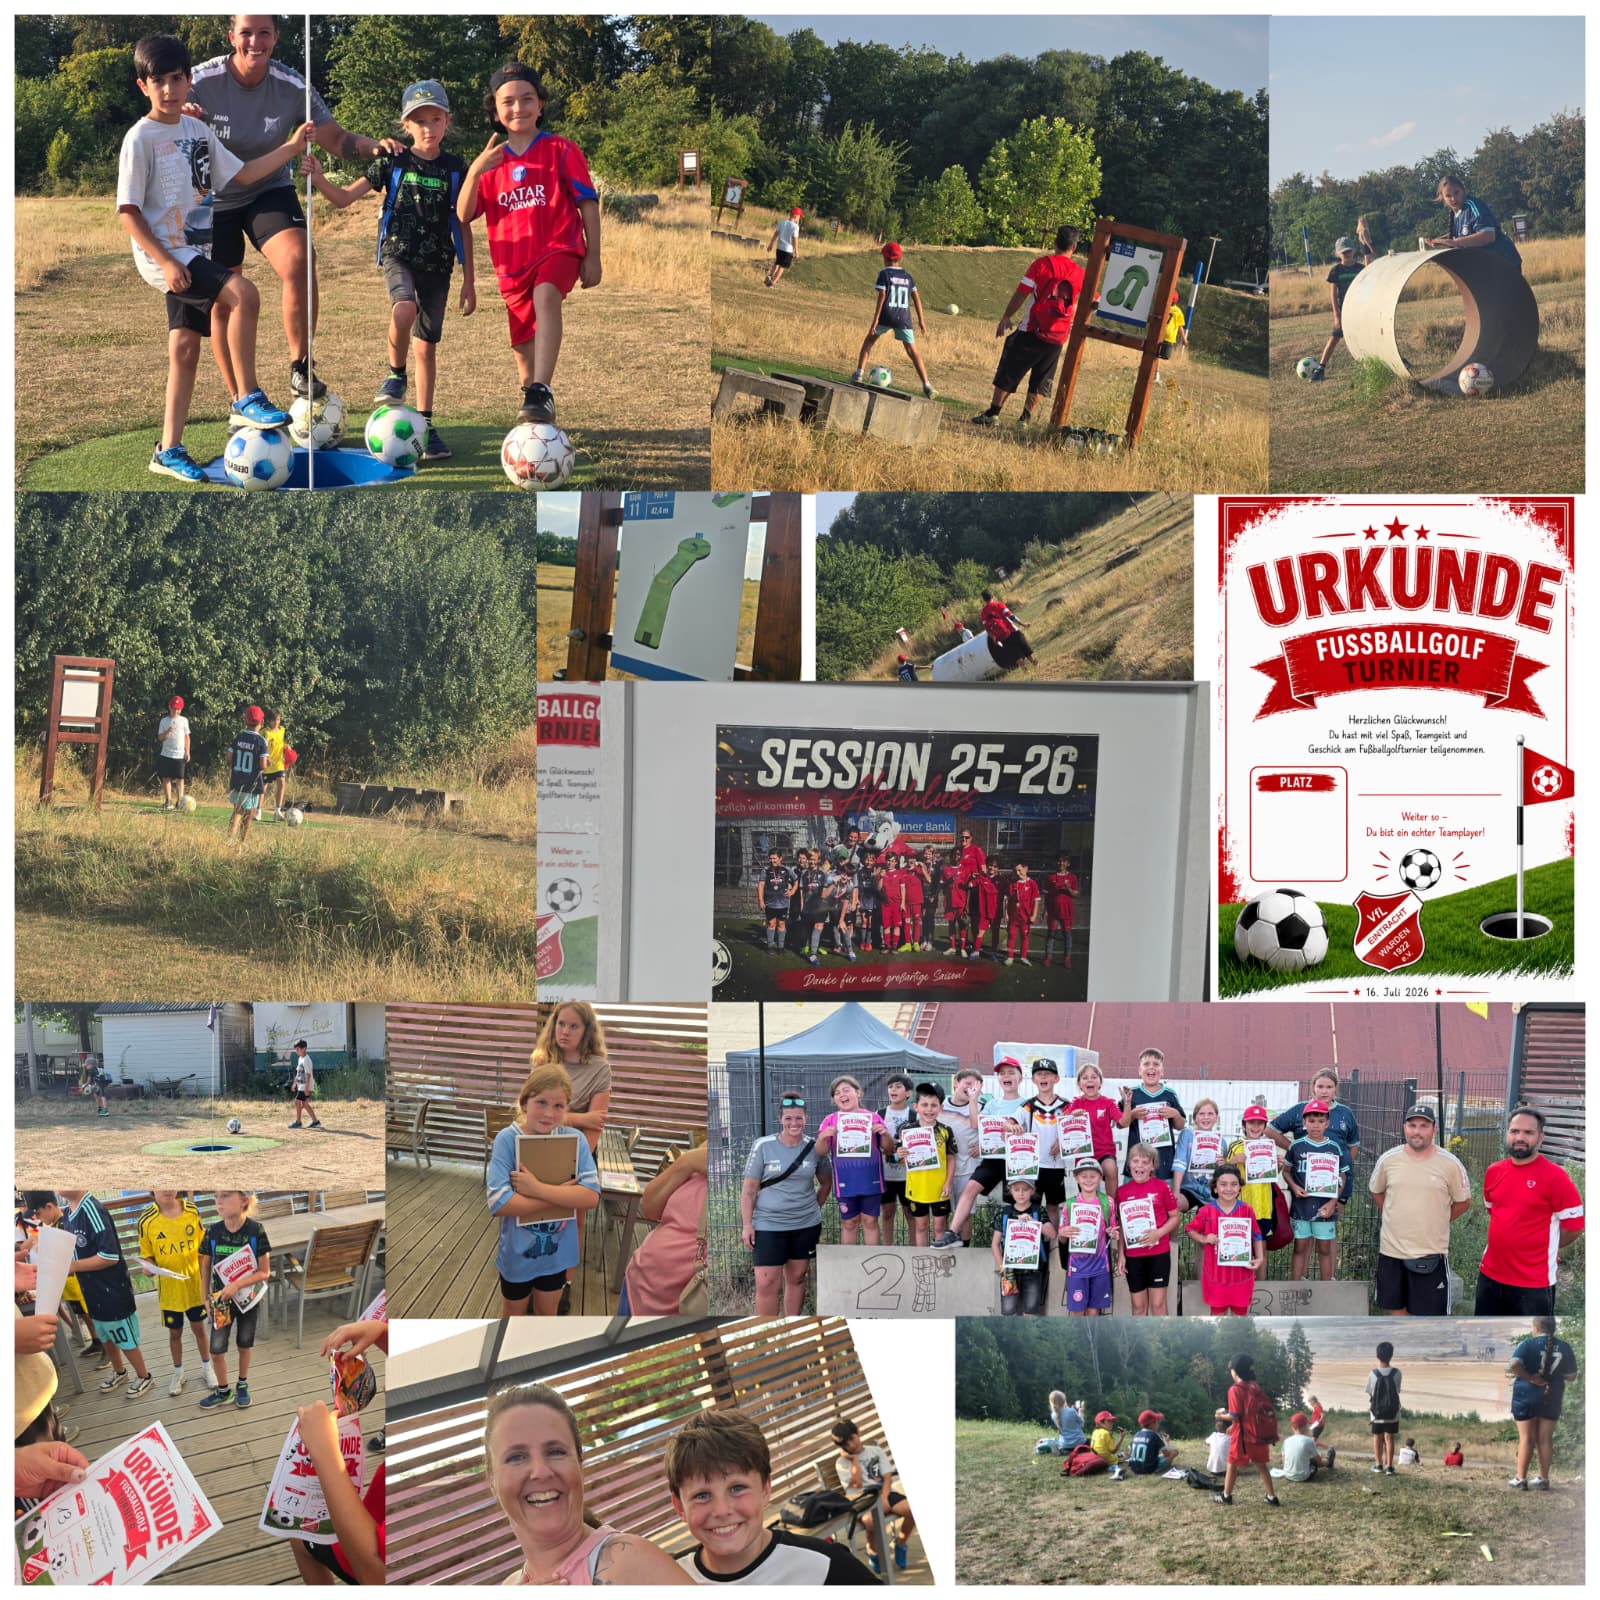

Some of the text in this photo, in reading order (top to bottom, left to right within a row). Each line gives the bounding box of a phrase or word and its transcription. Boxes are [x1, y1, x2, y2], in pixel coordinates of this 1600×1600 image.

[498, 184, 546, 207] QATAR
[508, 198, 546, 212] AIRWAYS
[888, 285, 908, 308] 10
[630, 502, 640, 518] 11
[1246, 544, 1565, 634] URKUNDE
[1316, 630, 1487, 662] FUSSBALLGOLF
[1342, 658, 1462, 686] TURNIER
[1349, 714, 1447, 725] Herzlichen Glückwunsch!
[1329, 730, 1468, 742] Du hast mit viel Spaß, Teamgeist und
[1308, 744, 1342, 754] Geschick
[1359, 744, 1427, 756] Fußballgolfturnier
[1430, 744, 1486, 756] teilgenommen.
[234, 750, 254, 772] 10
[757, 738, 1080, 794] SESSION 25-26
[1280, 775, 1314, 790] PLATZ
[838, 771, 980, 818] Abschluss
[926, 821, 952, 832] Bank
[1402, 812, 1428, 821] Weiter
[1366, 826, 1485, 840] Du bist ein echter Teamplayer!
[1366, 906, 1388, 922] VfL
[1368, 907, 1408, 945] EINTRACHT
[1378, 928, 1411, 957] WARDEN
[1392, 941, 1410, 958] 1922
[803, 968, 968, 988] Danke für eine großartige Saison!
[1366, 987, 1429, 997] 16. Juli 2026
[222, 1254, 252, 1277] URKUNDE
[856, 1253, 906, 1310] 2
[109, 1326, 128, 1344] 10
[1538, 1350, 1562, 1376] 17
[1131, 1443, 1148, 1462] 10
[120, 1480, 148, 1533] FUSSBALLGOLF
[124, 1446, 183, 1550] URKUNDE
